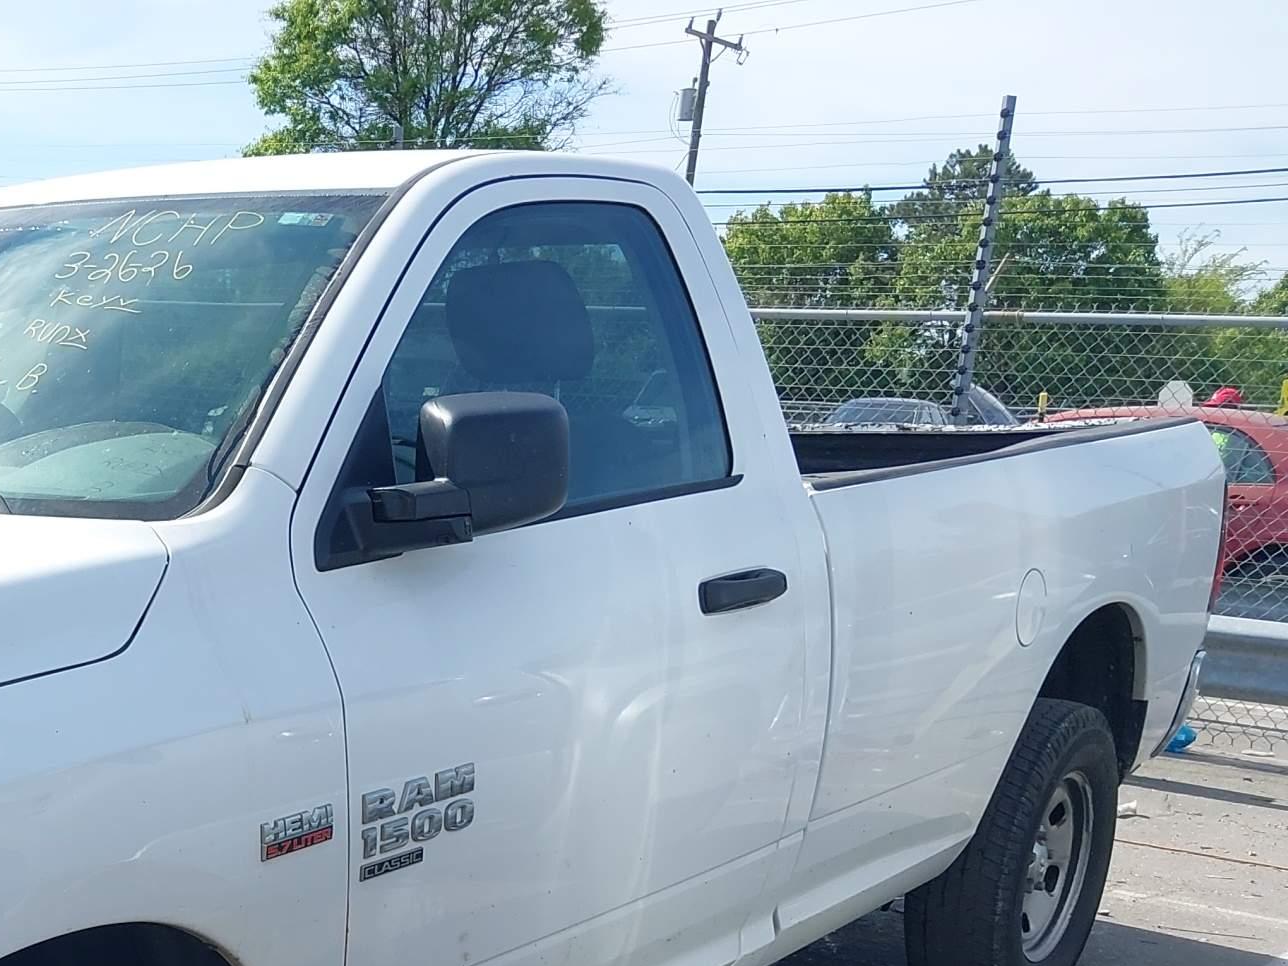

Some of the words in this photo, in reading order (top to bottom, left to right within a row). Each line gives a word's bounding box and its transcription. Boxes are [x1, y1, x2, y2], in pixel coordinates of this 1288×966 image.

[362, 762, 475, 825] RAM
[260, 803, 333, 845] HEMI
[362, 797, 475, 860] 1500
[363, 850, 423, 880] CLASSIC
